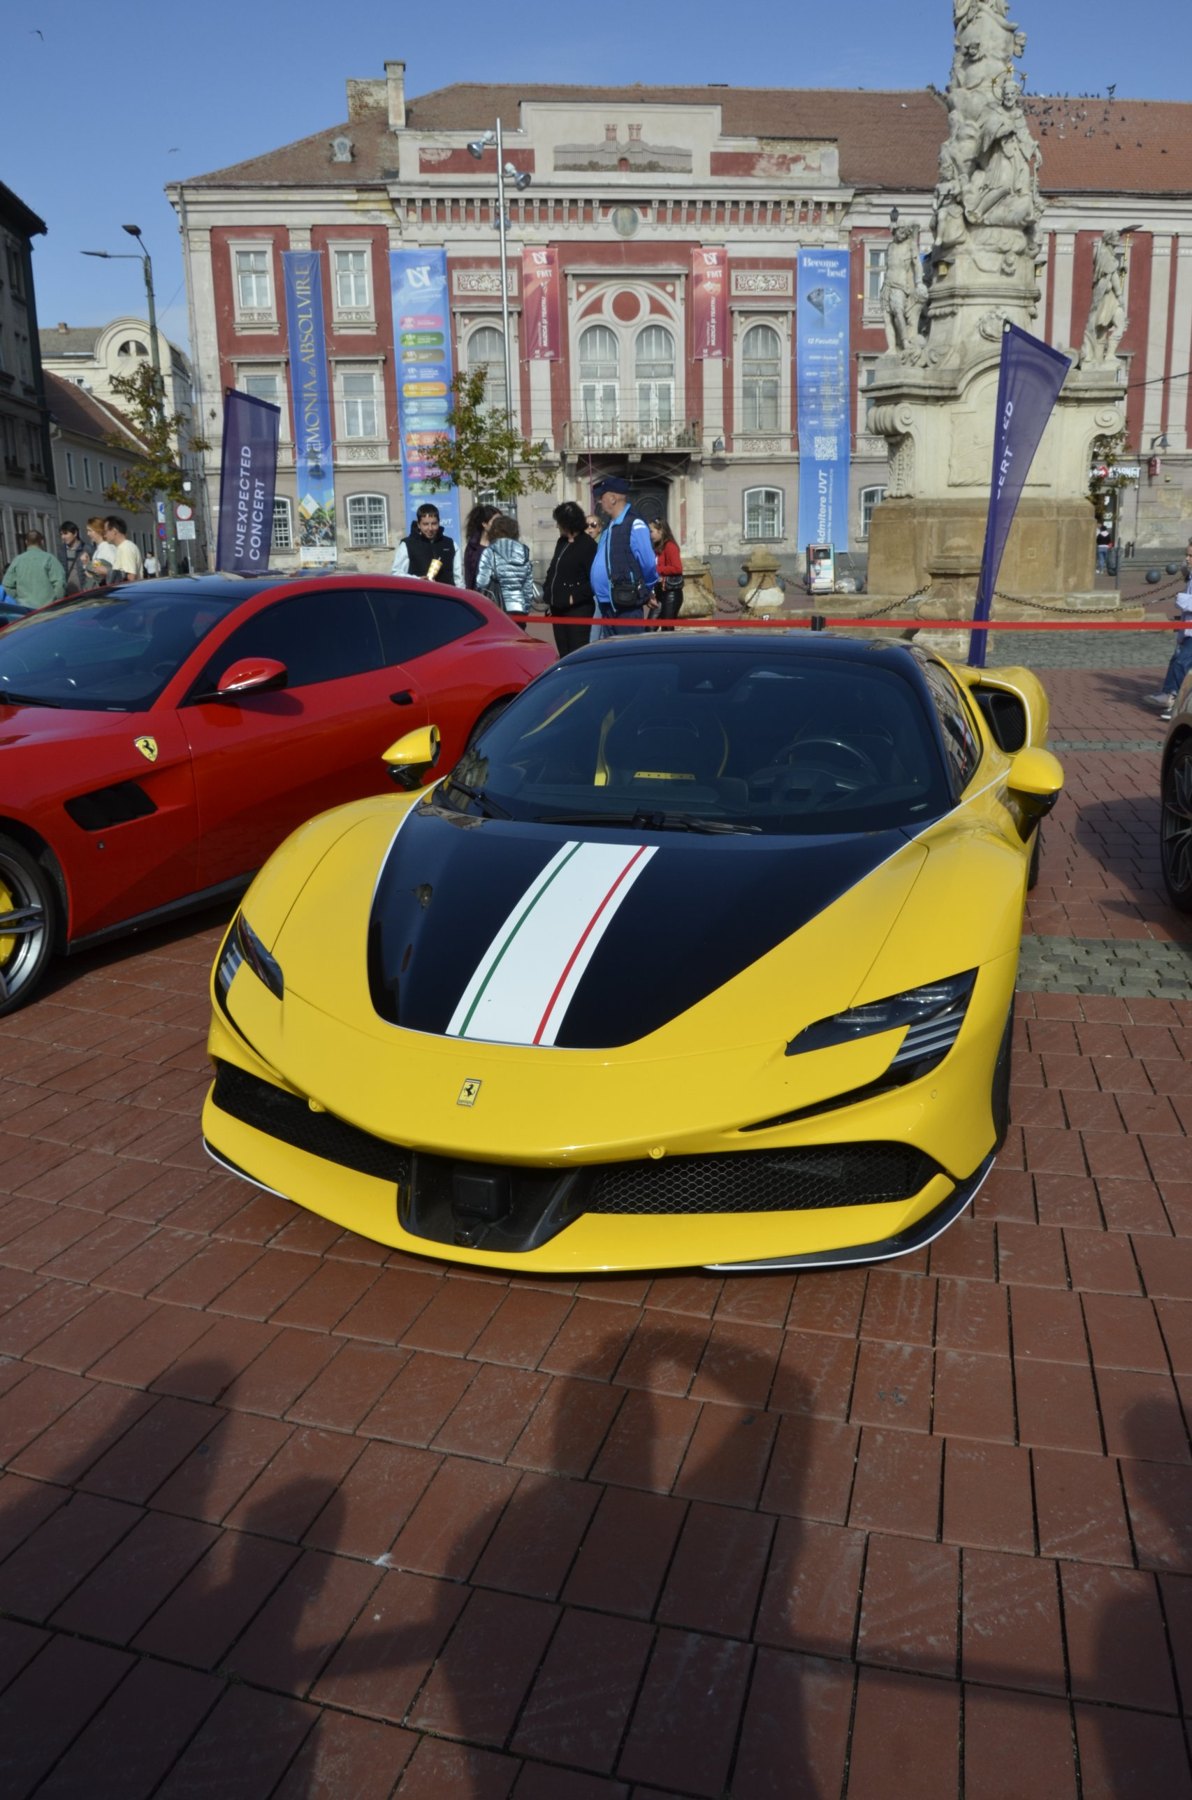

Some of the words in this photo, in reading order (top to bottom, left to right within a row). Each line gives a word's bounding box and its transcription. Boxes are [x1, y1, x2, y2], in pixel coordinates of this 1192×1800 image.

[295, 264, 317, 366] ABSOLVIRE
[234, 445, 252, 558] UNEXPECTED
[249, 478, 265, 561] CONCERT
[816, 496, 827, 544] Admitere
[818, 469, 828, 495] UVT
